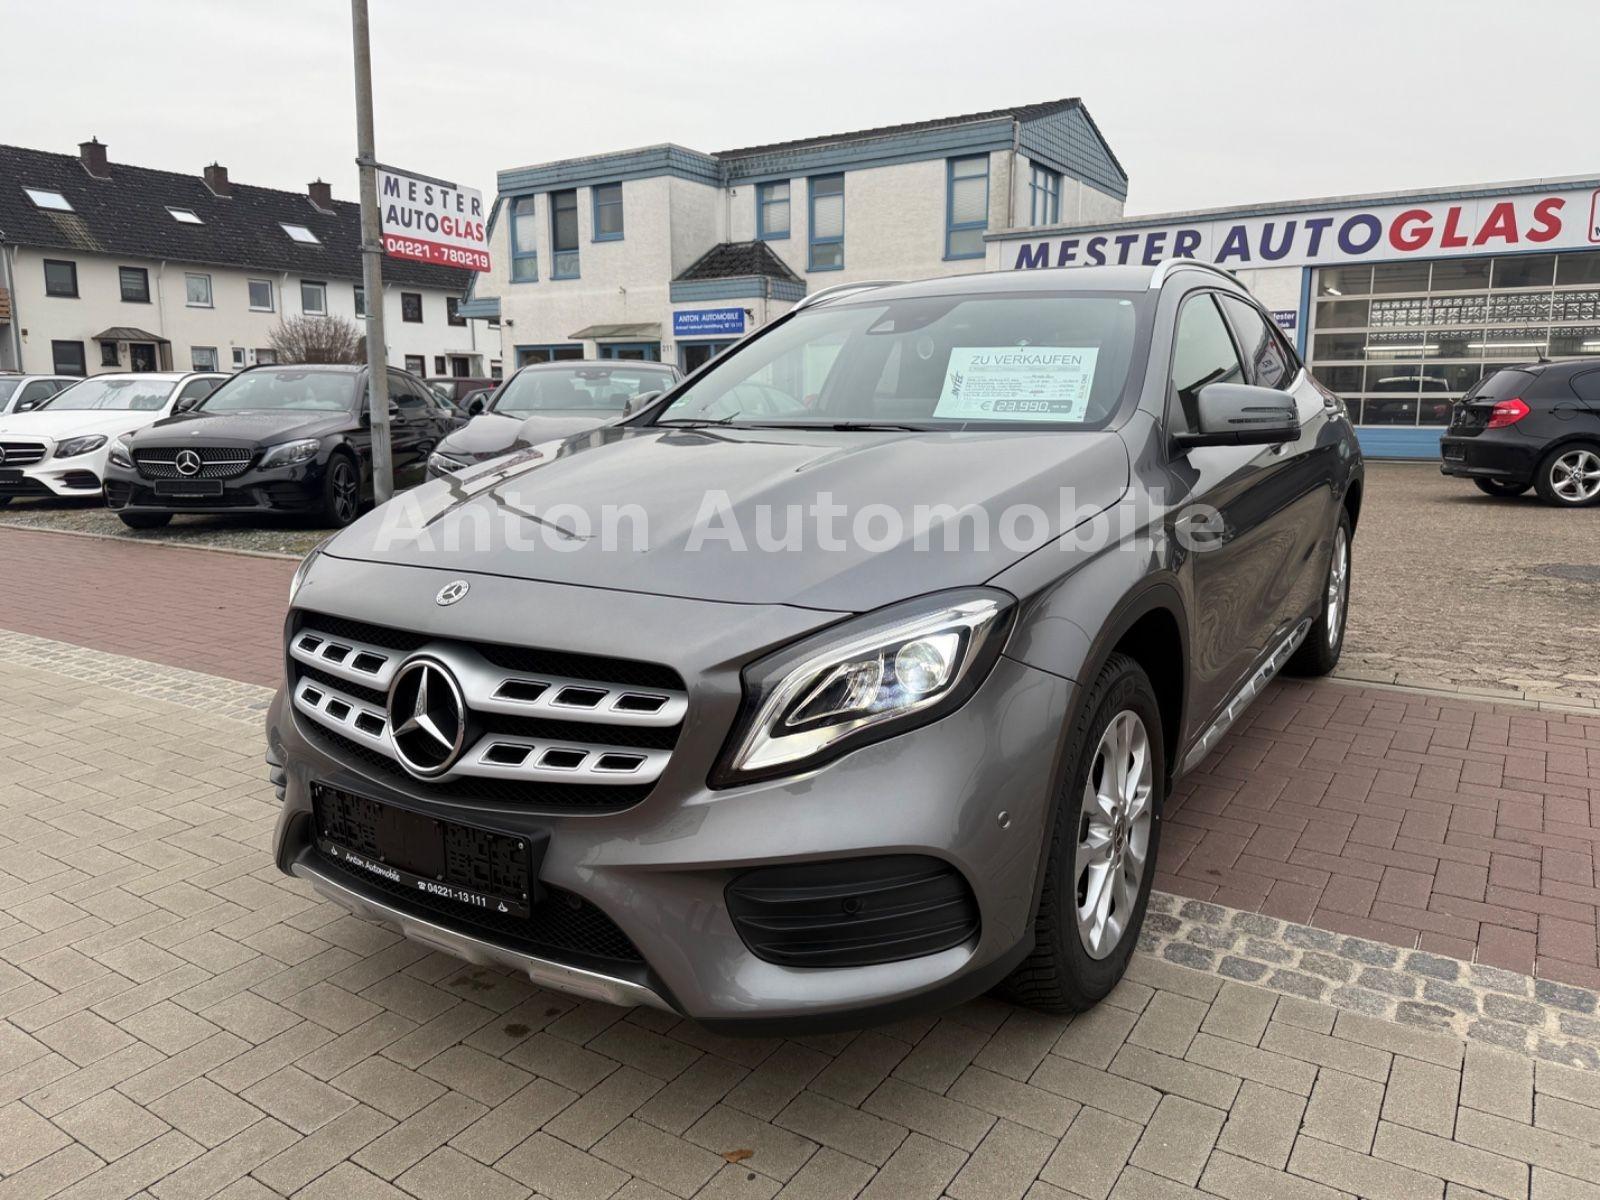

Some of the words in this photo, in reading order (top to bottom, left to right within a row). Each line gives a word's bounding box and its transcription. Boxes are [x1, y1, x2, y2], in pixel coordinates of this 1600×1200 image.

[384, 175, 481, 217] MESTER
[385, 204, 484, 243] AUTOGLAS
[1014, 229, 1202, 270] MESTER
[1213, 197, 1567, 264] AUTOGLAS
[387, 239, 430, 258] 04221
[441, 248, 488, 268] 780219
[678, 314, 699, 323] ANTON
[702, 312, 739, 322] AUTOMOBILE
[970, 355, 989, 365] ZU
[993, 354, 1082, 365] VERKAUFEN
[980, 400, 992, 411] €
[345, 852, 365, 869] Anton
[364, 859, 400, 883] Automobile
